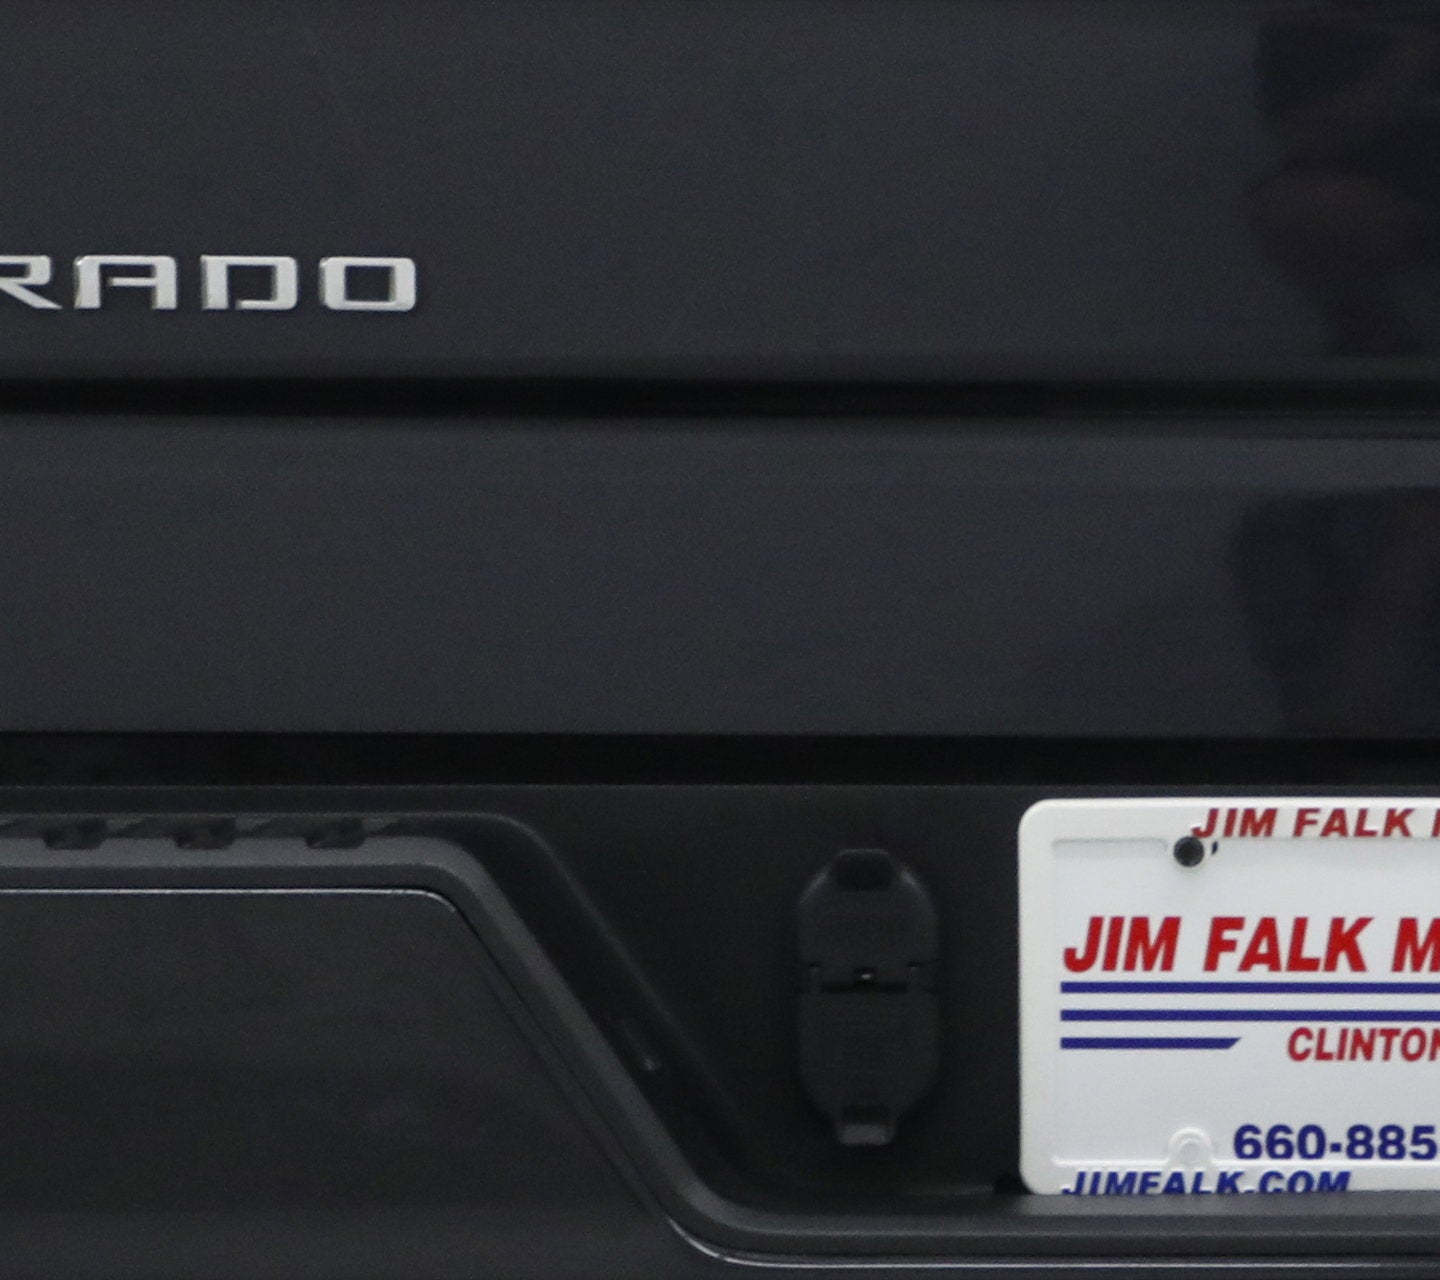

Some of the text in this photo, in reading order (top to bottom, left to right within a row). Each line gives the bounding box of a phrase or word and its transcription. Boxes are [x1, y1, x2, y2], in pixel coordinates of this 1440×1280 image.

[1191, 807, 1279, 839] JIM
[1292, 807, 1415, 839] FALK
[1063, 916, 1181, 973] JIM
[1202, 916, 1373, 973] FALK
